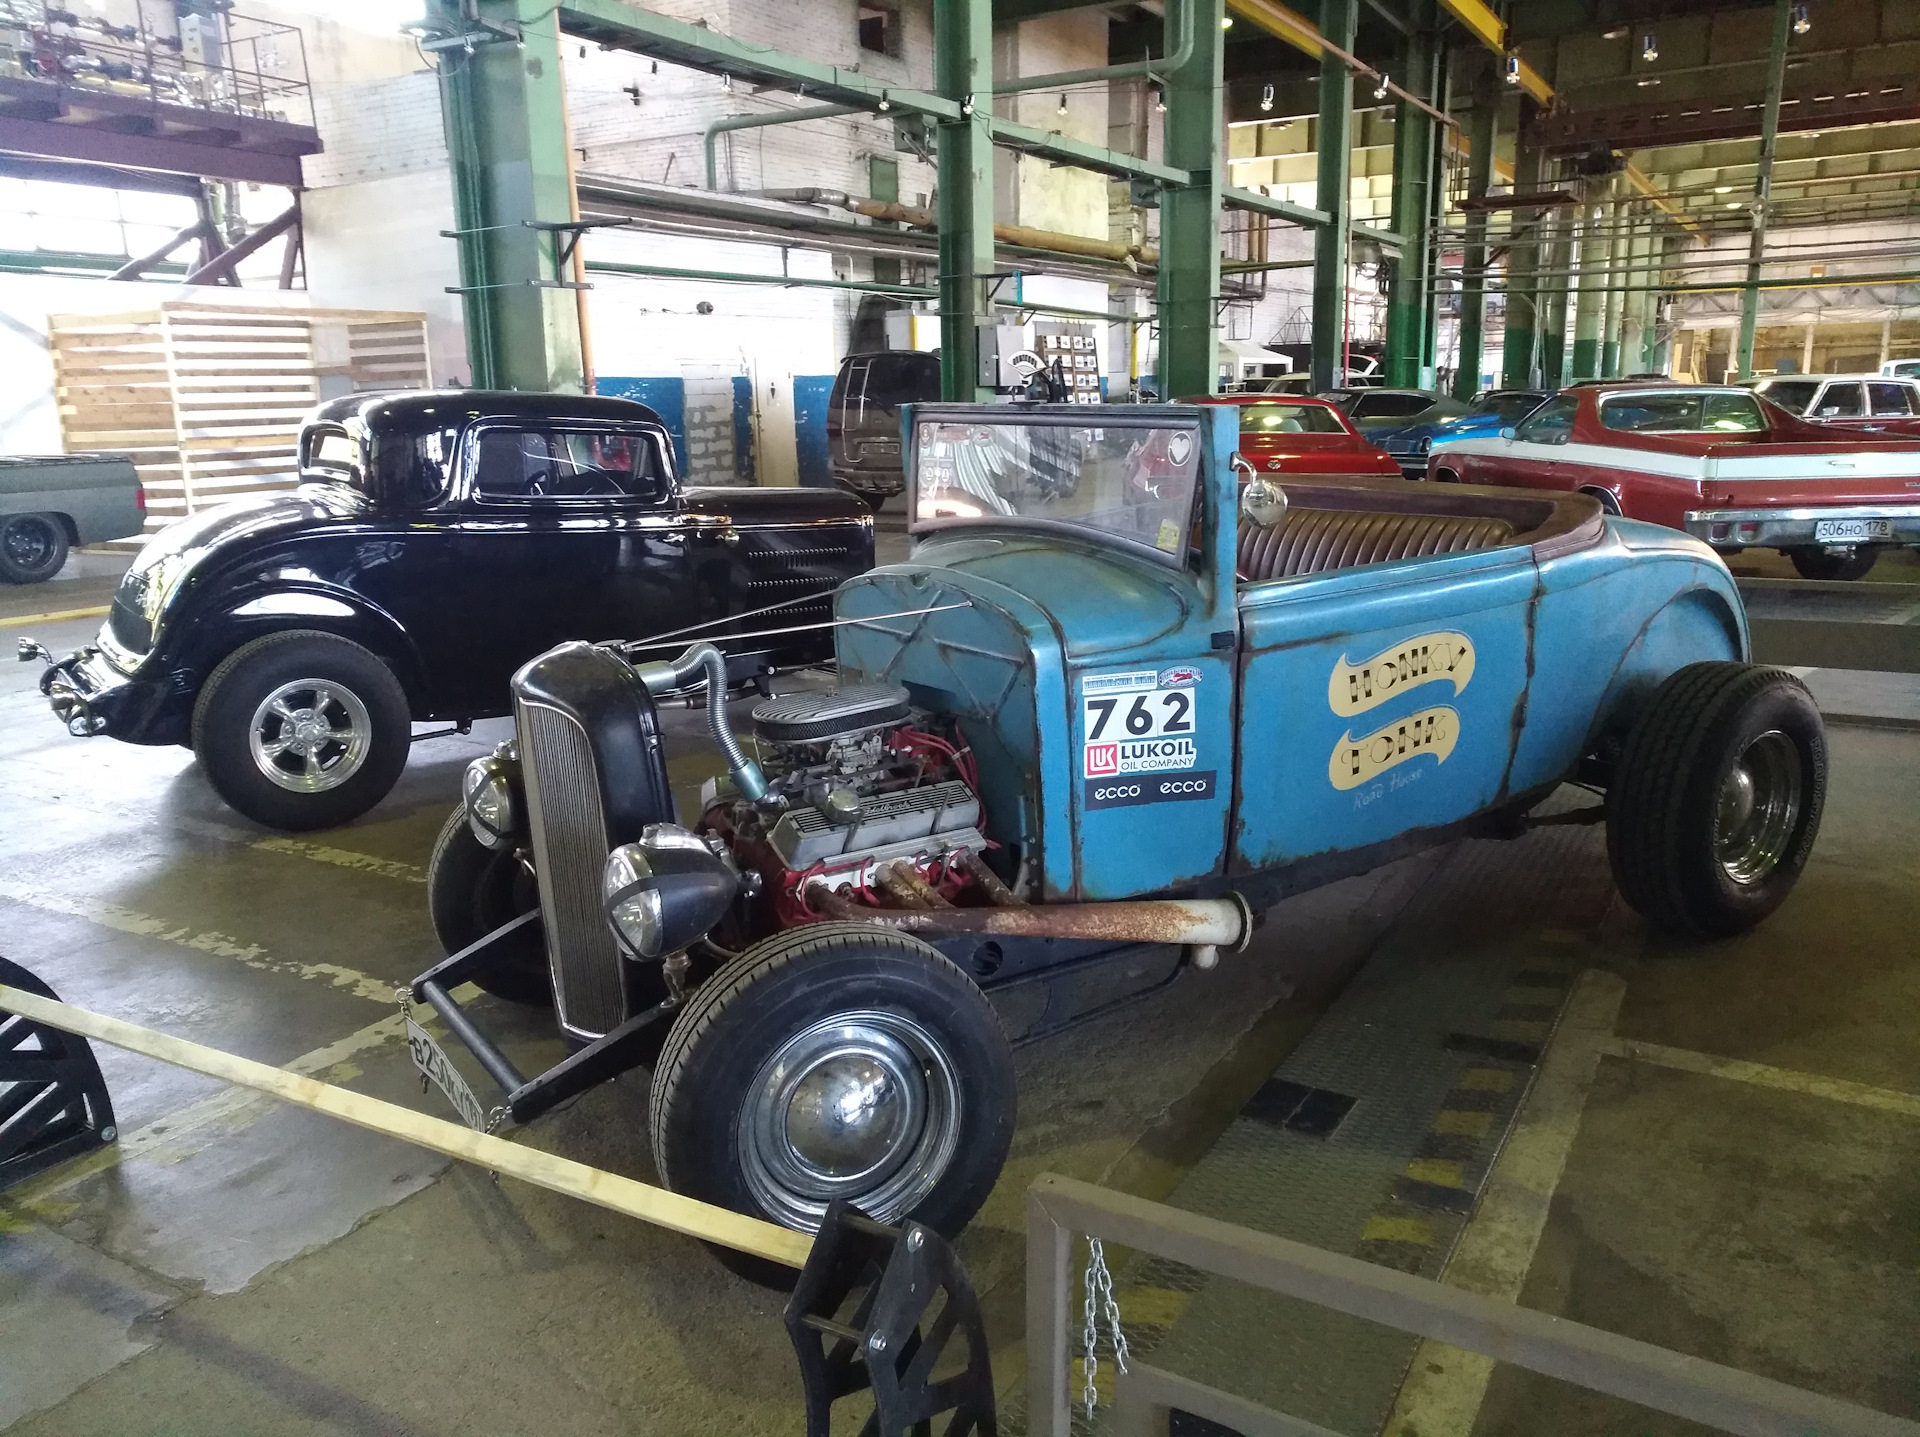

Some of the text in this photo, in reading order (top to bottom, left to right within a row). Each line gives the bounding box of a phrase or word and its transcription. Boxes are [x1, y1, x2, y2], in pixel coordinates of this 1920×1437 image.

[1348, 643, 1467, 704] HONKY
[1087, 692, 1190, 740] 762
[1121, 741, 1194, 760] LUKOIL
[1341, 714, 1447, 776] TONK
[1121, 757, 1194, 770] OIL COMPANY
[1094, 778, 1207, 801] ecco ecco
